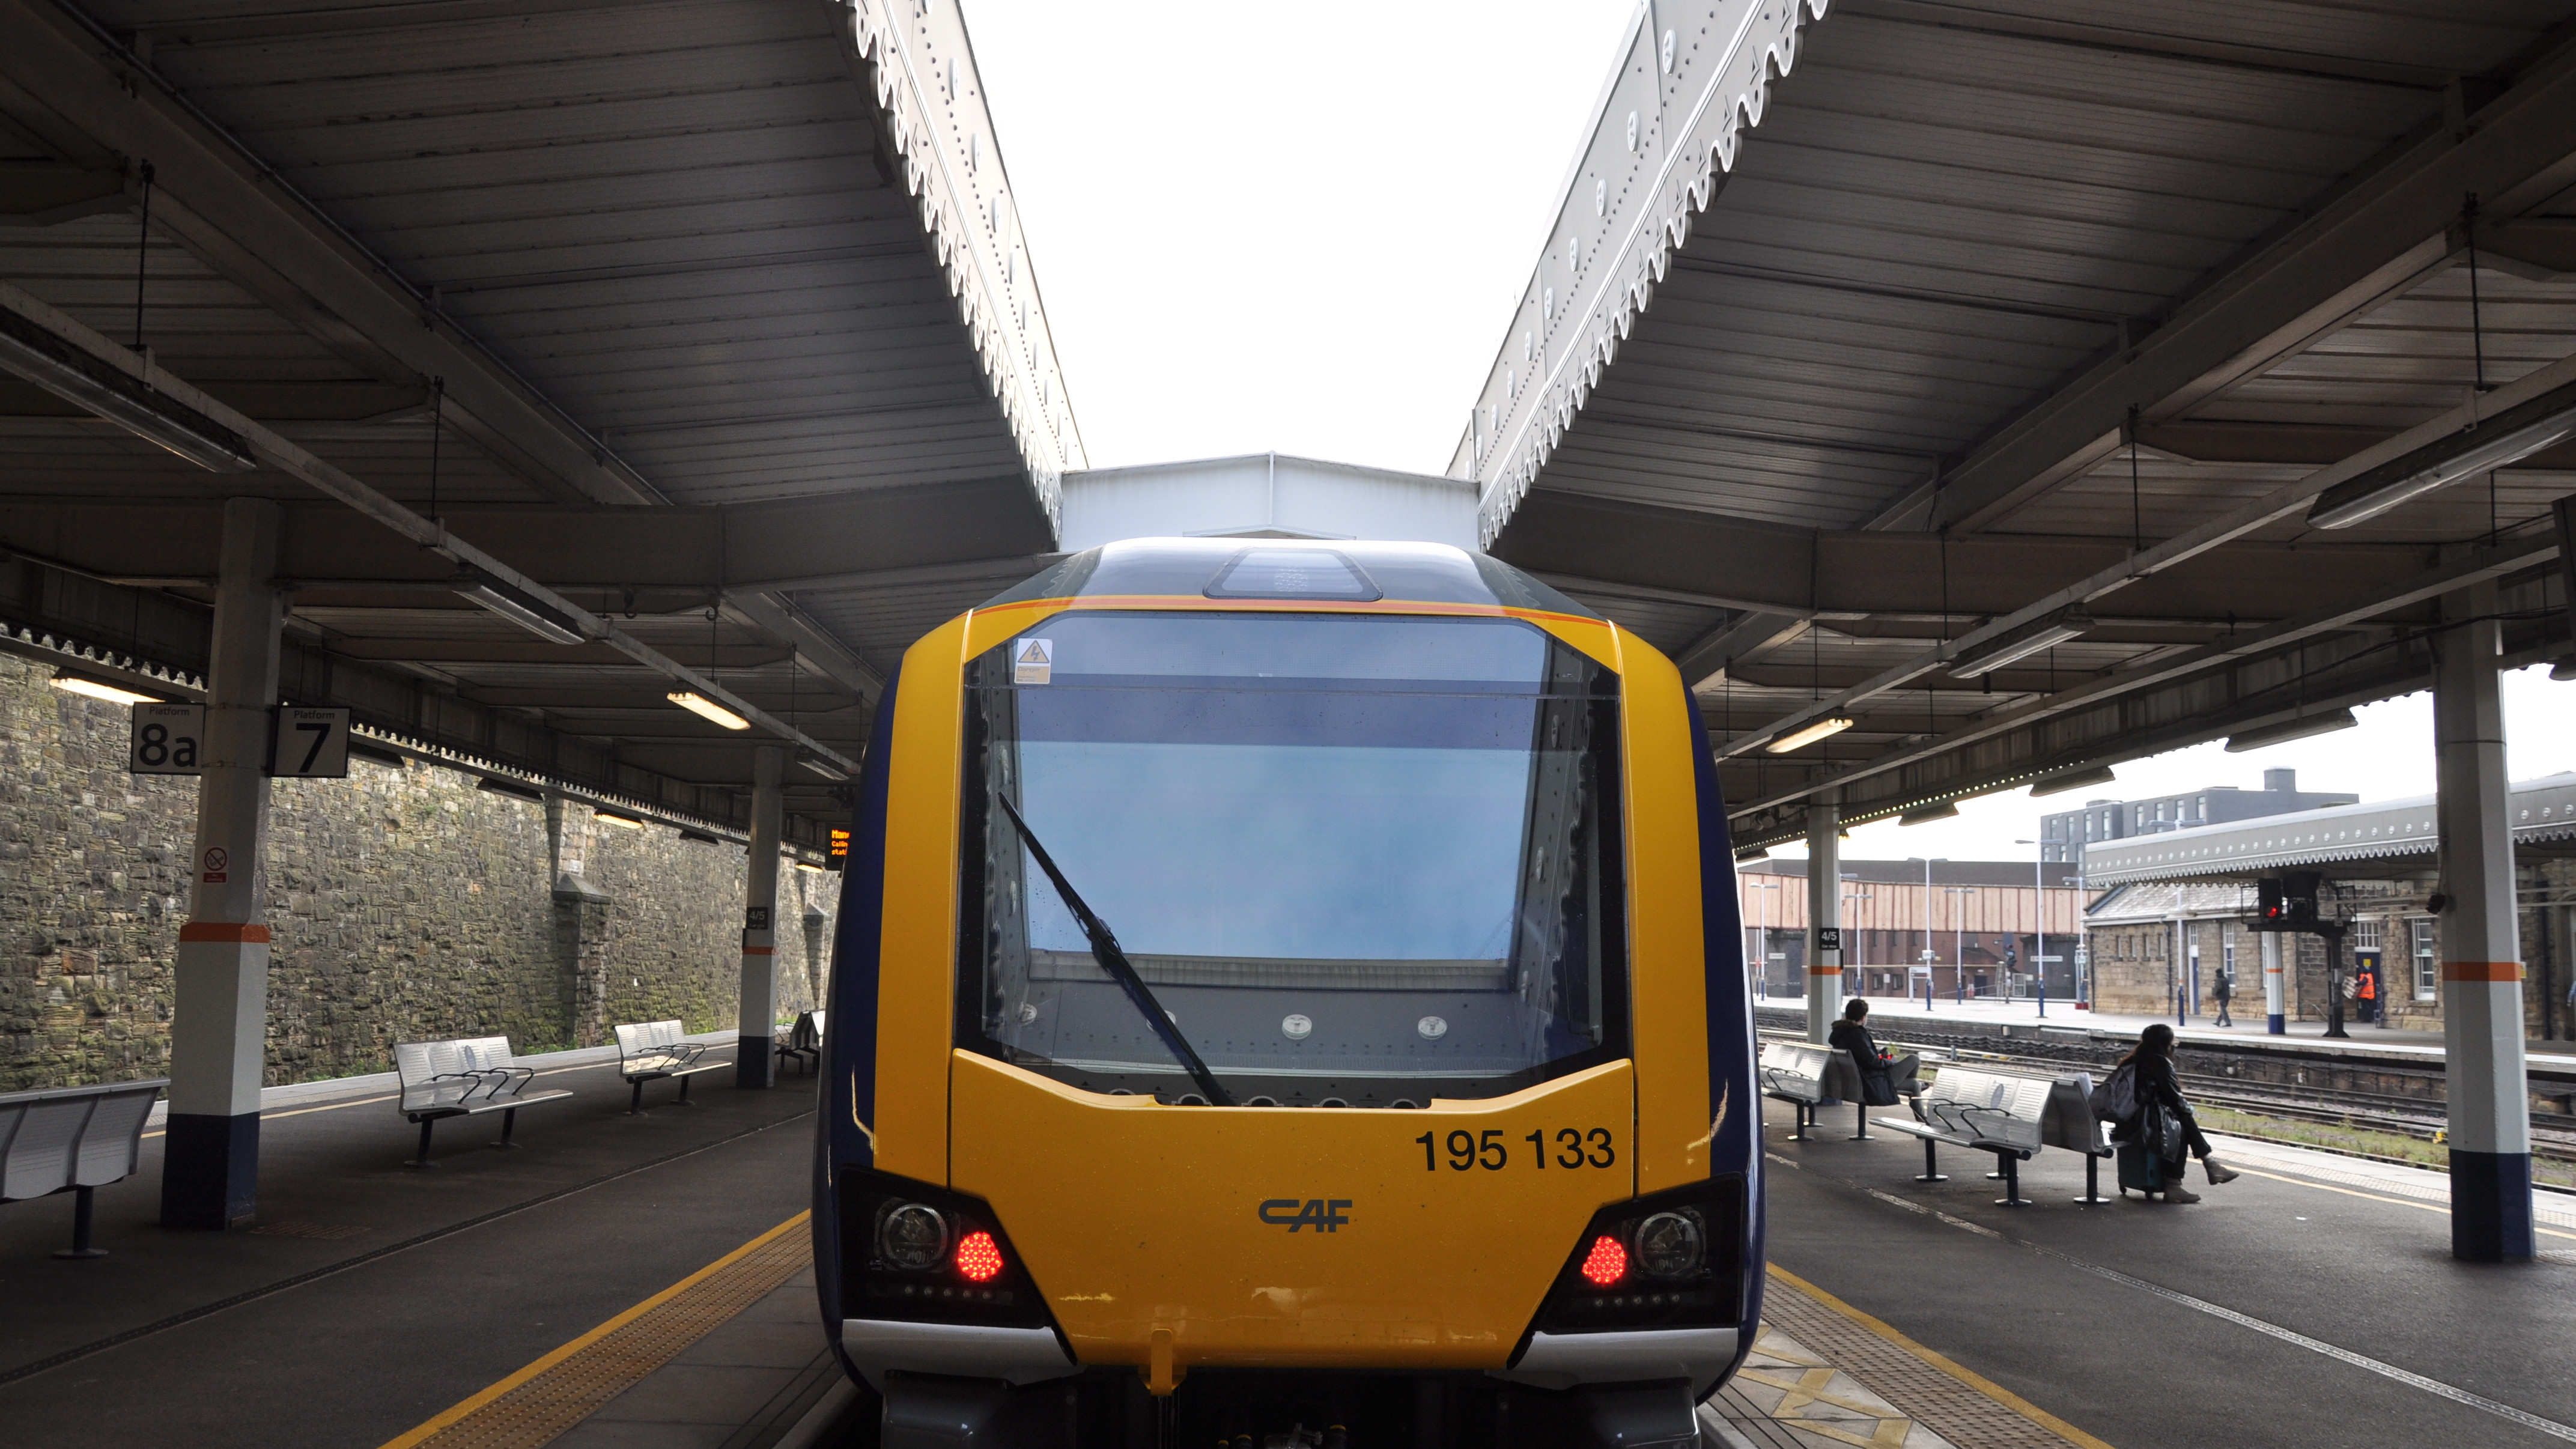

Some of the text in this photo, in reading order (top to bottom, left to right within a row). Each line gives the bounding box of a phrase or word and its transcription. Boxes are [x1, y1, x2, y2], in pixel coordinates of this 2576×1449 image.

[149, 706, 190, 716] Platform
[294, 710, 335, 720] Platform
[139, 723, 197, 767] 8a
[296, 723, 331, 773] 7
[750, 911, 765, 920] 4/5
[1821, 931, 1837, 941] 4/5
[1415, 1128, 1615, 1171] 195 133
[1258, 1199, 1353, 1233] CAF
